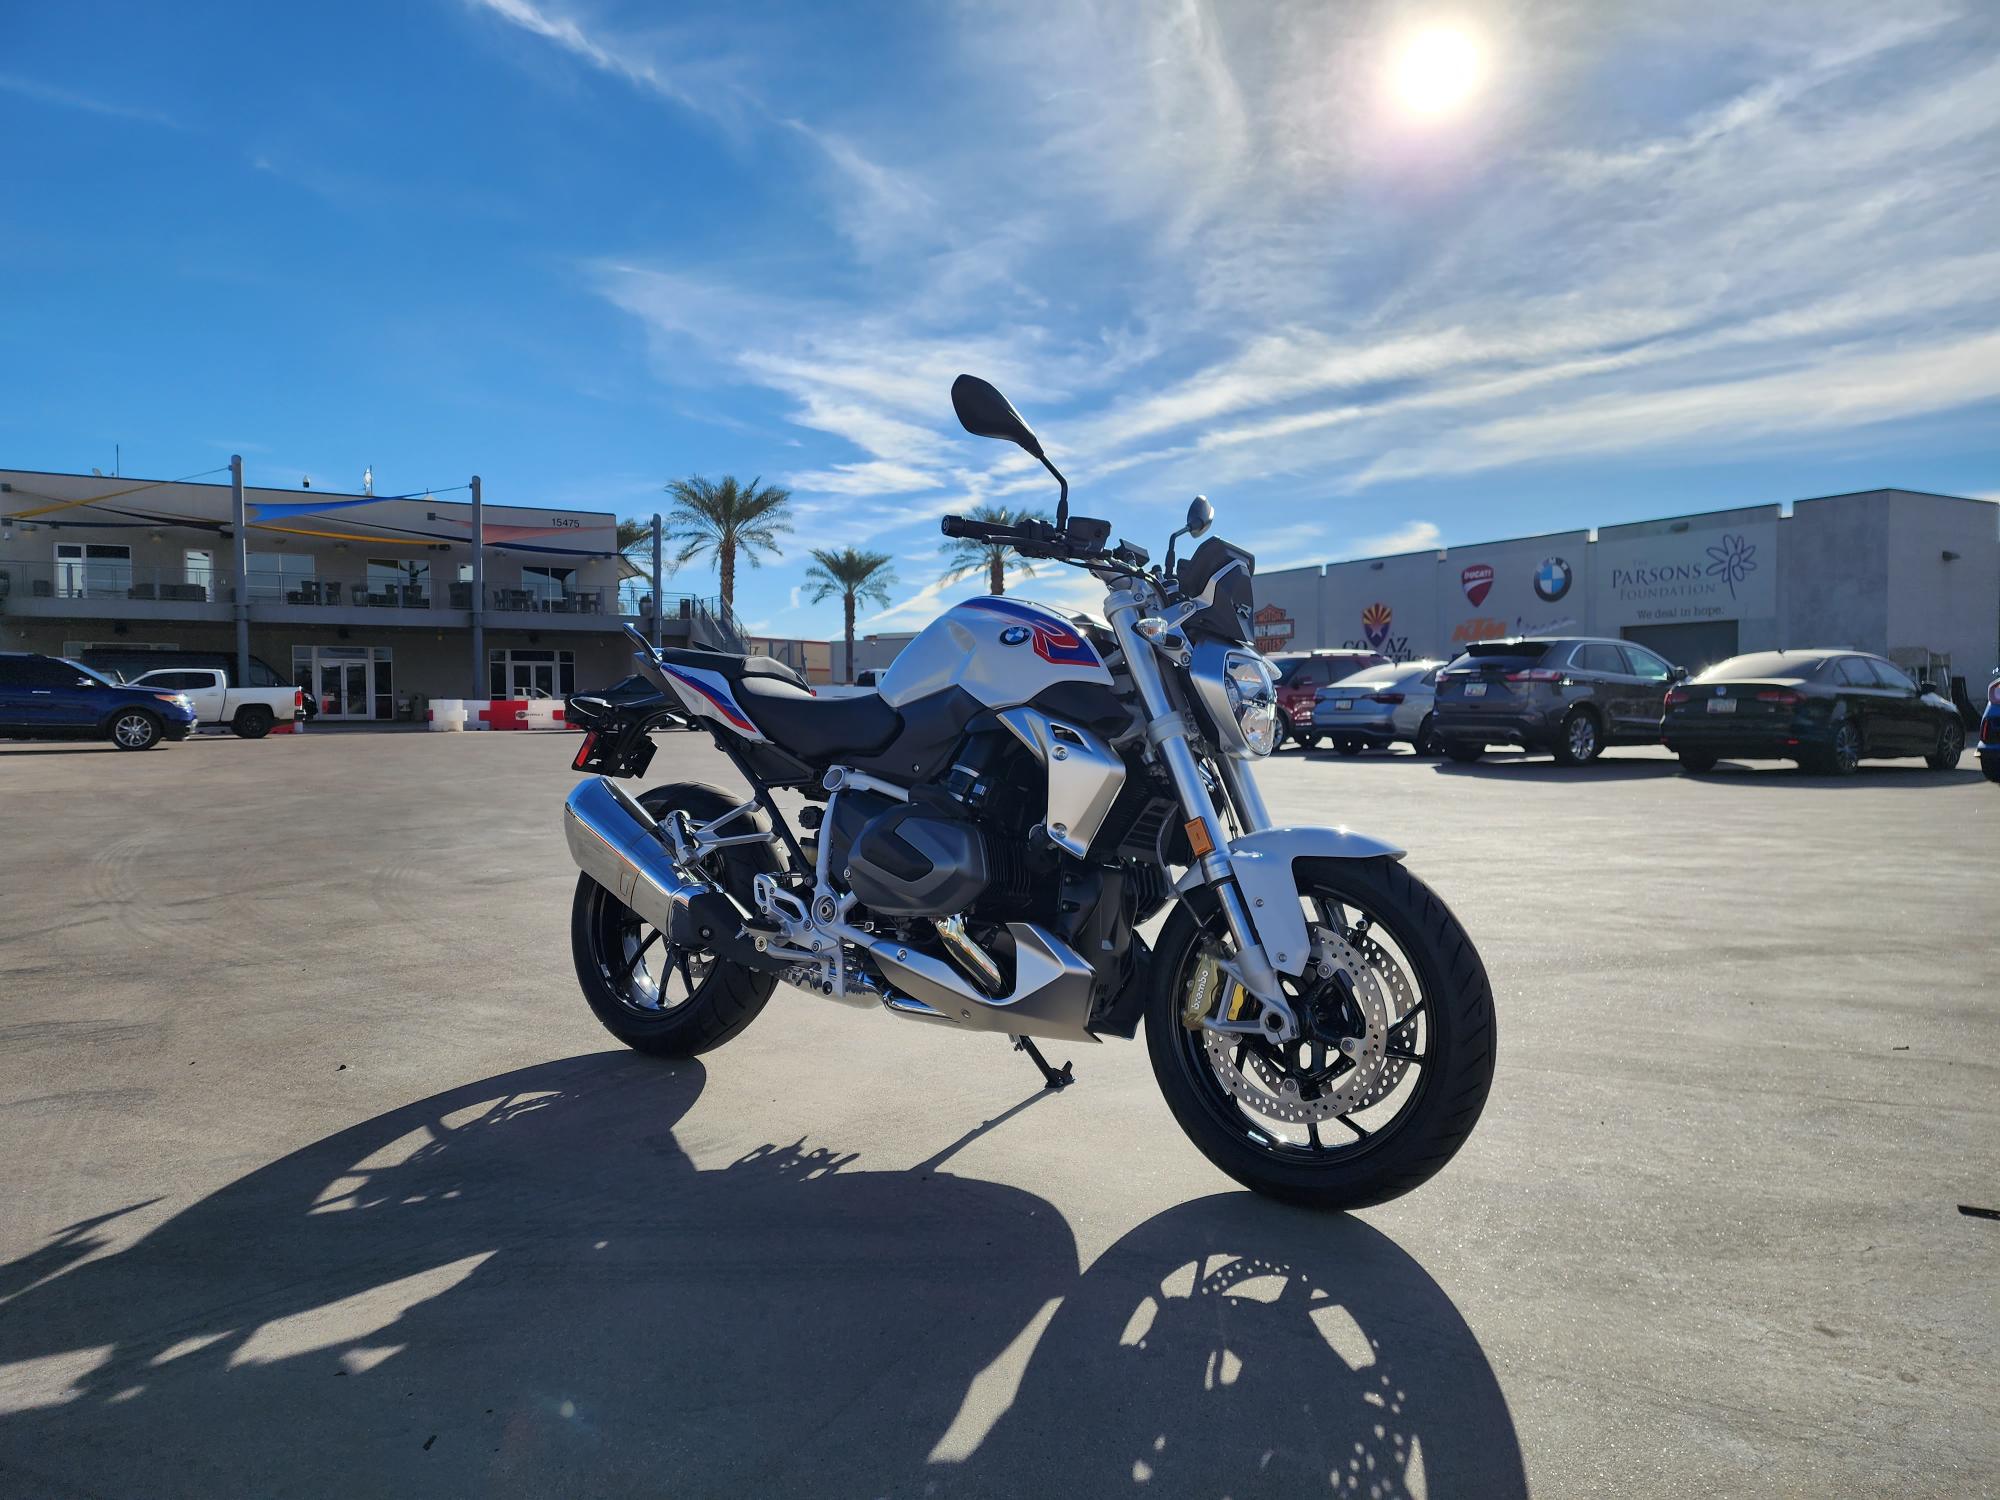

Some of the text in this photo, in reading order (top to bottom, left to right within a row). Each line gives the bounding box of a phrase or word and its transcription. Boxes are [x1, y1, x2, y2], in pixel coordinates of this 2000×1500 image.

[551, 518, 580, 528] 15475
[1464, 570, 1493, 580] DUCATI
[1612, 564, 1702, 588] PARSONS
[1620, 584, 1717, 600] FOUNDATION
[1637, 605, 1725, 619] We deal in hope.
[1385, 637, 1408, 653] AZ
[1192, 970, 1209, 1010] brembo
